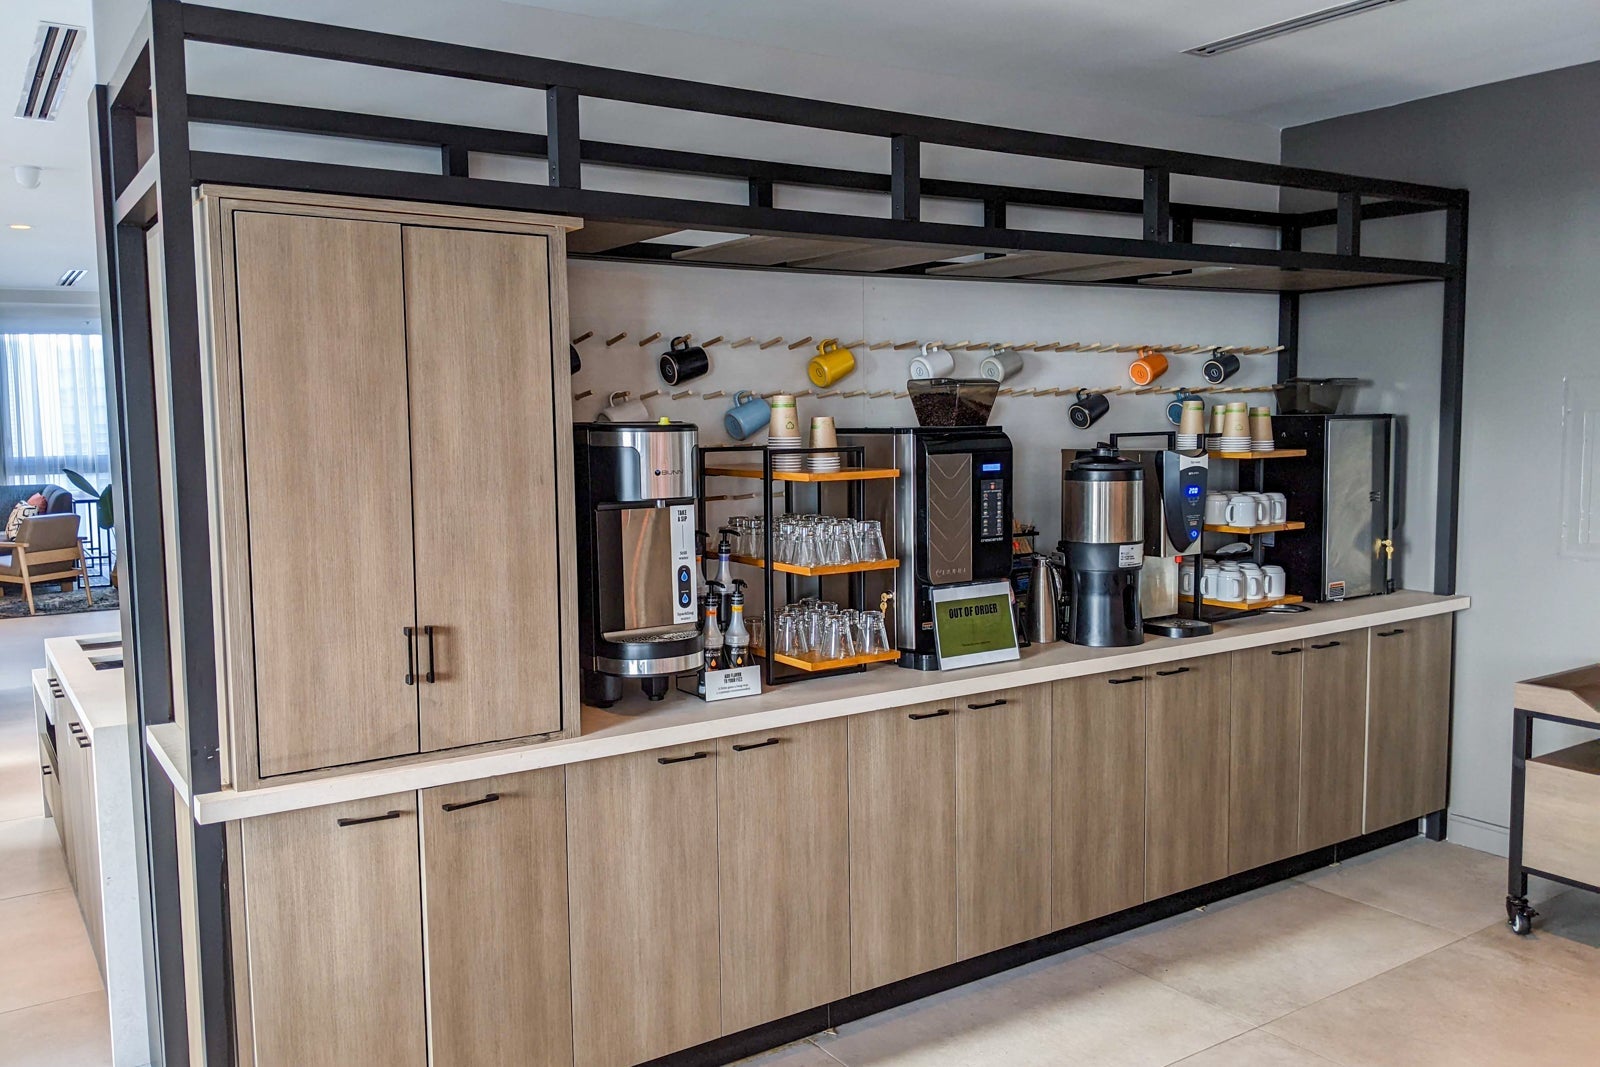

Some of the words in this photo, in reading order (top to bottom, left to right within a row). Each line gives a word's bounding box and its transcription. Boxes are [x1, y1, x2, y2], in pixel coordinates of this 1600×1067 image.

[948, 607, 963, 619] OUT
[964, 605, 974, 617] OF
[974, 603, 998, 616] ORDER
